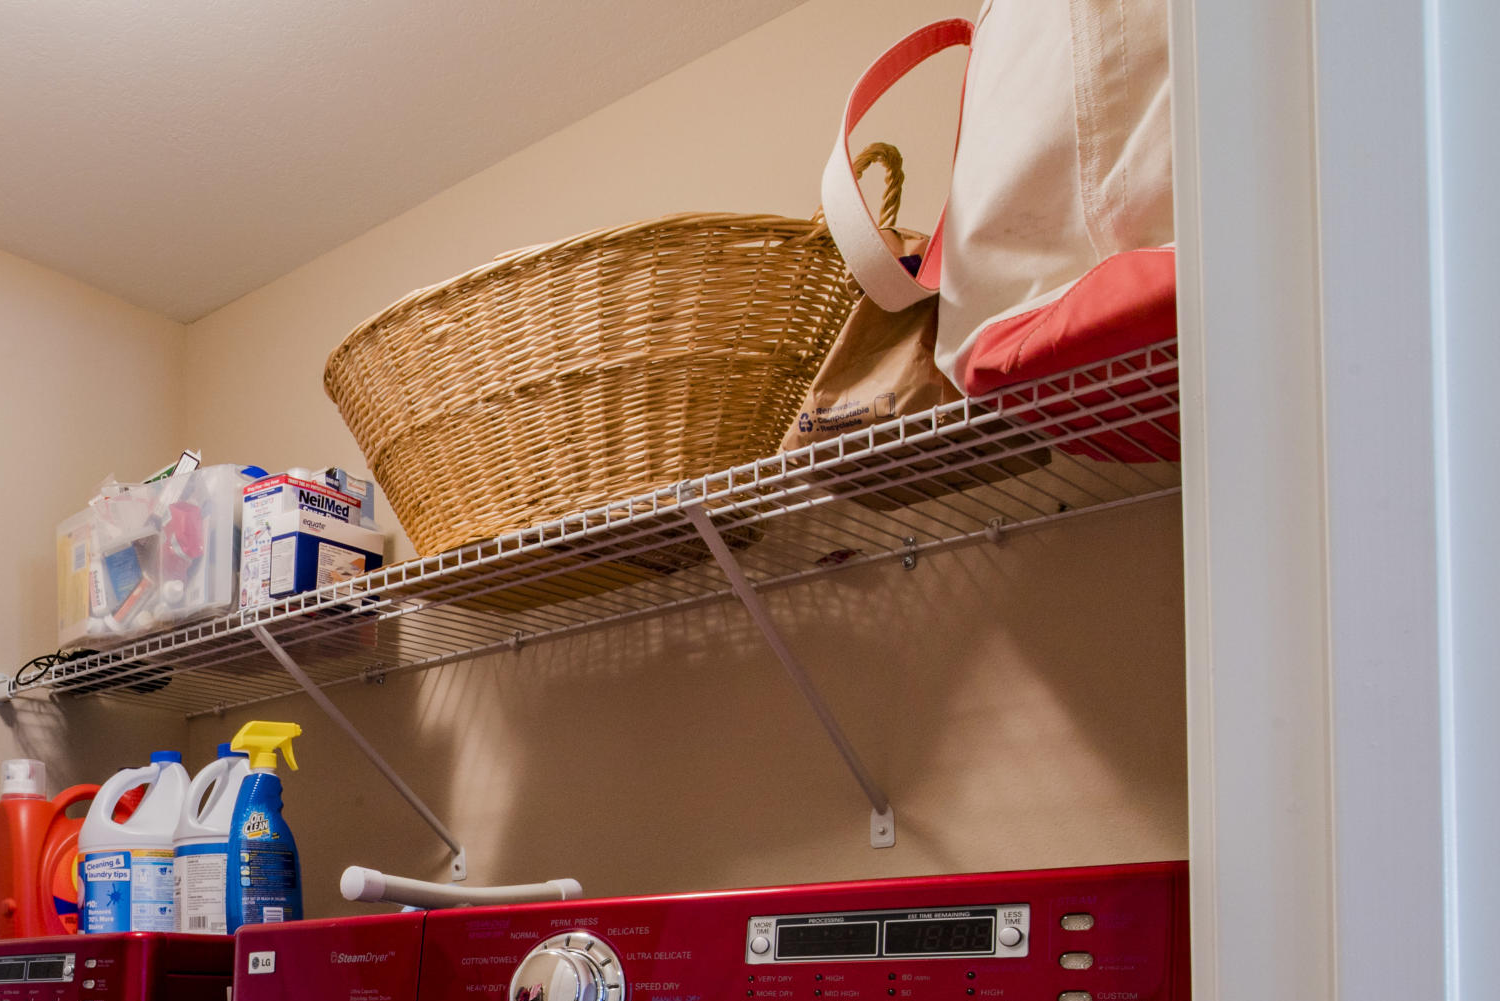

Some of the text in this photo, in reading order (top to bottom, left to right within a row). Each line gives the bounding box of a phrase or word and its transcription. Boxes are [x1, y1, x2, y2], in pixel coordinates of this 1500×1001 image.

[817, 407, 870, 423] Compostable
[820, 418, 862, 432] Recyclable
[299, 489, 350, 518] NeilMed
[302, 518, 327, 530] equate
[243, 820, 269, 834] CLEAN
[86, 860, 114, 871] Cleaning
[88, 871, 112, 879] laundry
[550, 917, 599, 928] PERM. PRESS
[510, 931, 541, 939] NORMAL
[607, 926, 650, 936] DELICATES
[626, 951, 692, 961] ULTRA DELICATE
[261, 958, 271, 967] LG
[757, 975, 793, 983] VERY DRY
[466, 984, 507, 992] HEAVY DUTY
[635, 982, 680, 991] SPEED DRY
[756, 990, 794, 998] MORE DRY
[824, 990, 860, 998] MID HIGH
[900, 989, 912, 997] 50
[1097, 991, 1139, 1000] CUSTOM
